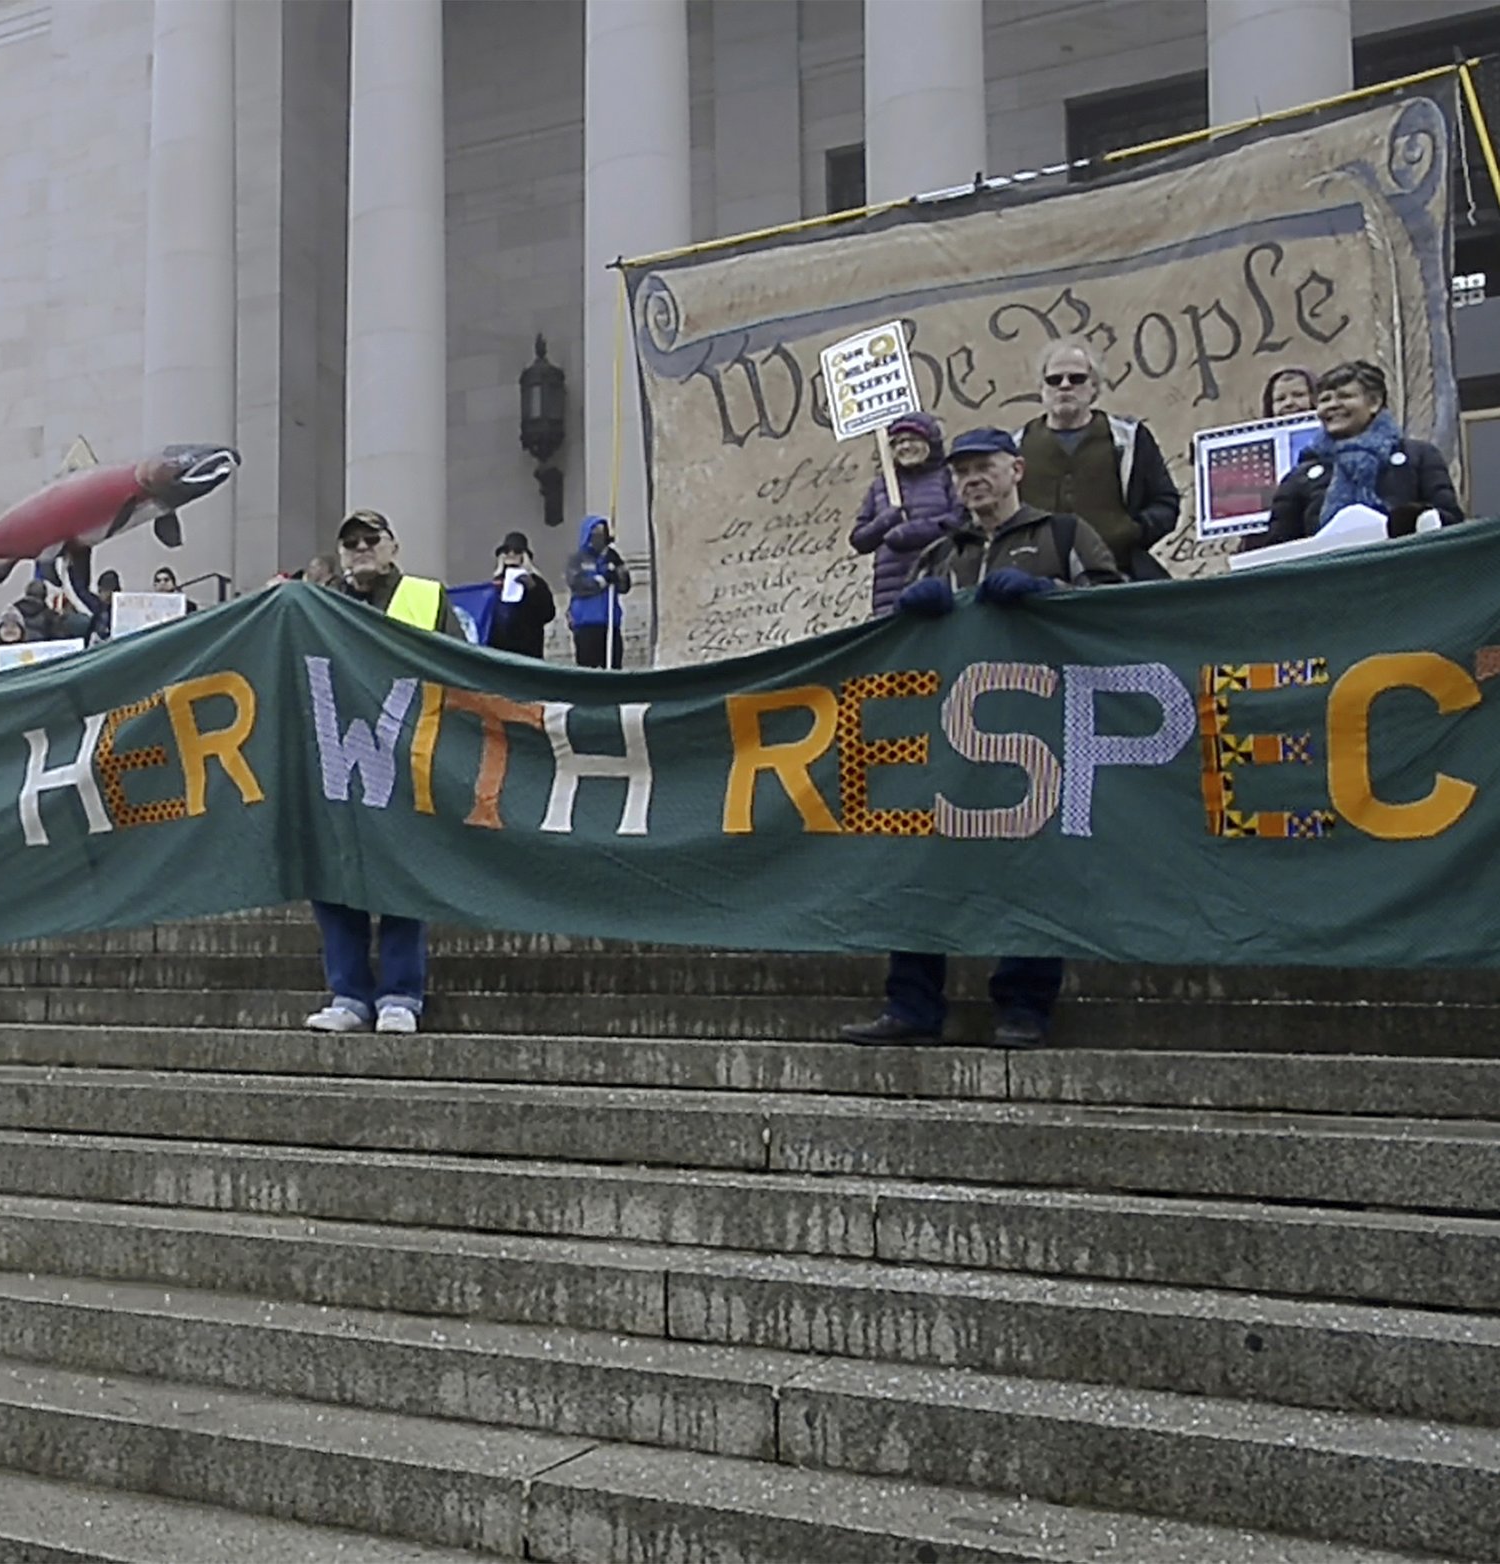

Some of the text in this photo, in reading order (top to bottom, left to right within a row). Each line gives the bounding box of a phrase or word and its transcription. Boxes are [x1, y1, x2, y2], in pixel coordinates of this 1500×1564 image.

[838, 369, 902, 400] DESERVE
[841, 386, 909, 419] BETTER
[757, 458, 813, 504] of
[19, 670, 265, 846] HER
[305, 655, 653, 835] WITH
